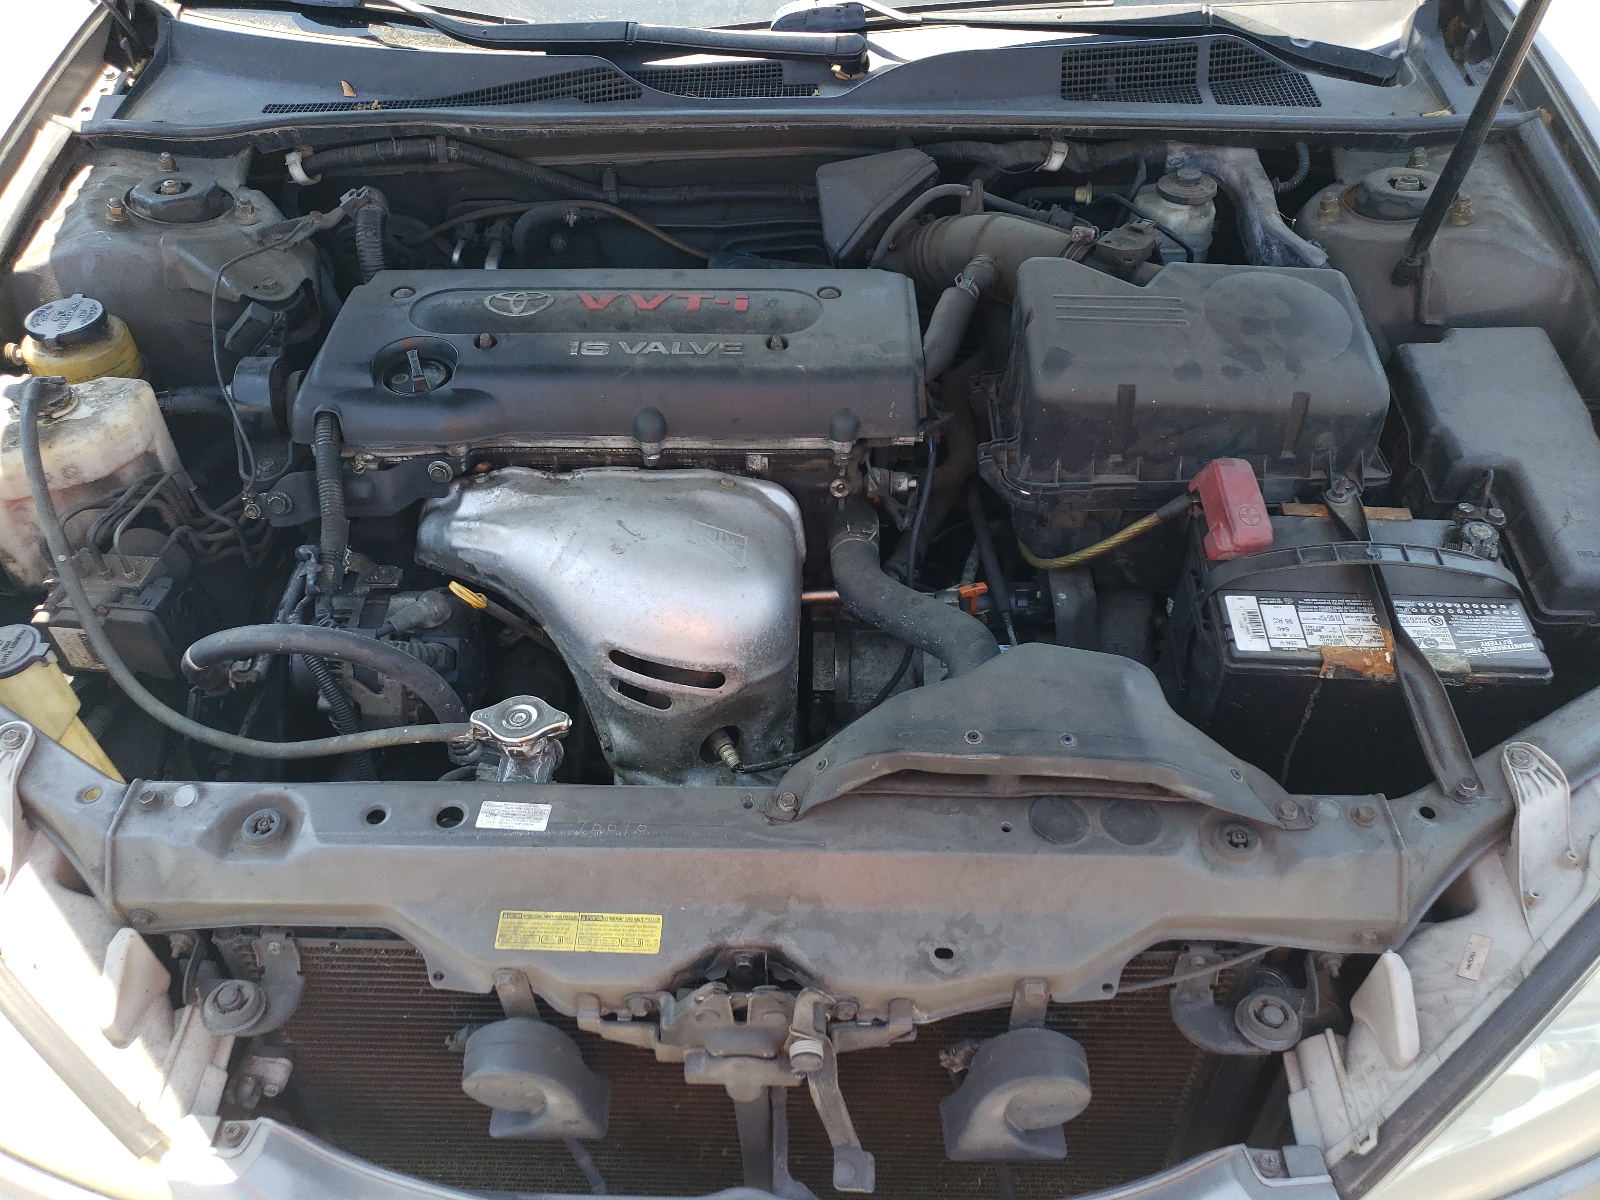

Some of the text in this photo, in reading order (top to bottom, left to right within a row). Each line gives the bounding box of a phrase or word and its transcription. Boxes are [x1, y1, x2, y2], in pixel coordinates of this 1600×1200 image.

[567, 341, 744, 356] 16 VALVE
[1462, 642, 1535, 655] MAINTENANCE-FREE
[1480, 638, 1512, 647] BATTERY
